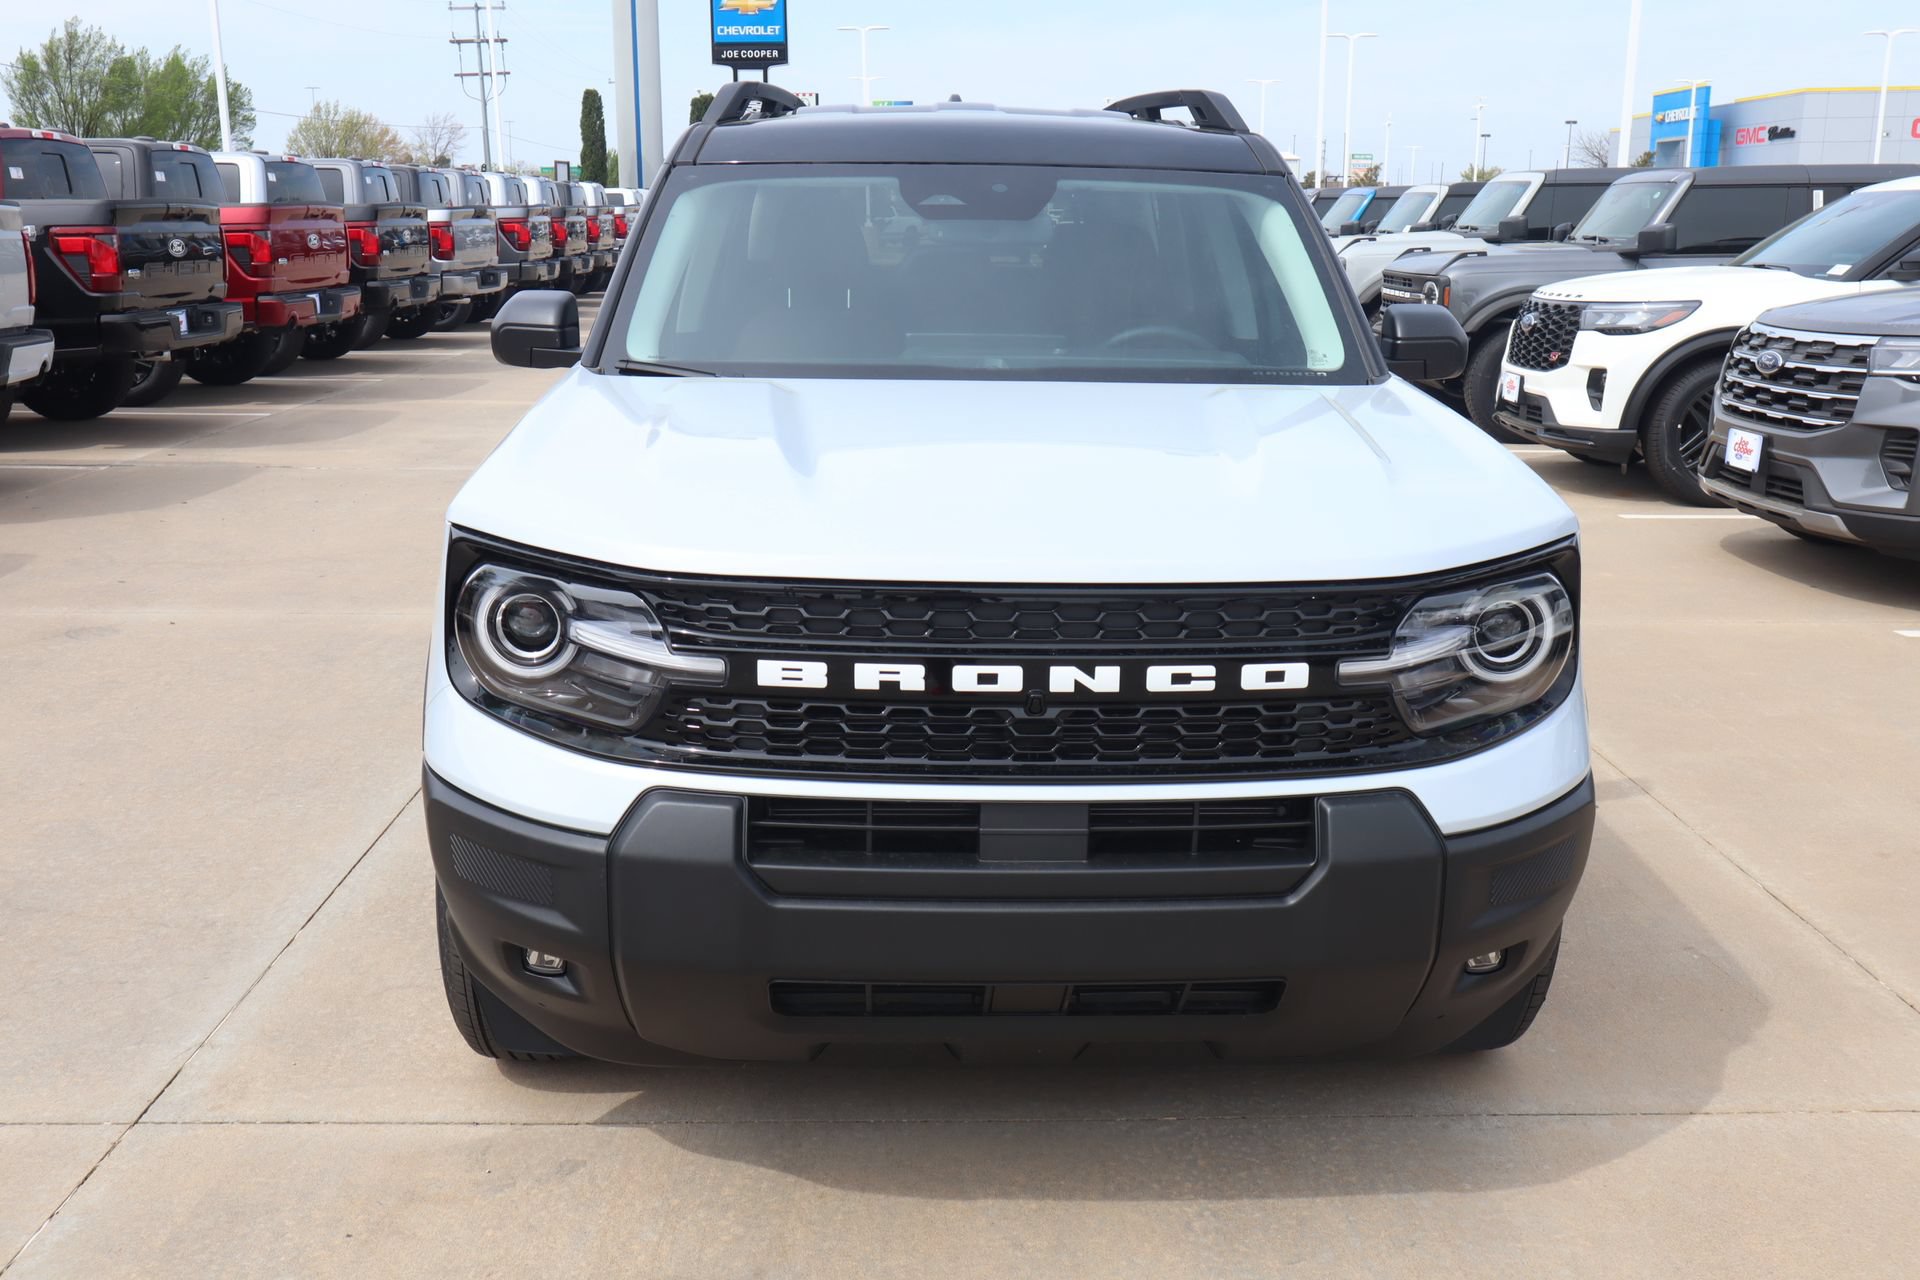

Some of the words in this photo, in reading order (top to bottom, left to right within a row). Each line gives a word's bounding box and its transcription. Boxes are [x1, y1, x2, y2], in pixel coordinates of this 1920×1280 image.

[717, 25, 781, 36] CHEVROLET
[721, 50, 739, 58] JOE
[741, 49, 779, 58] COOPER
[1665, 105, 1700, 123] CHEVROL
[1735, 126, 1767, 145] GMC
[1733, 441, 1754, 456] Cooper
[1738, 436, 1750, 447] Joe
[756, 658, 1310, 693] BRONCO
